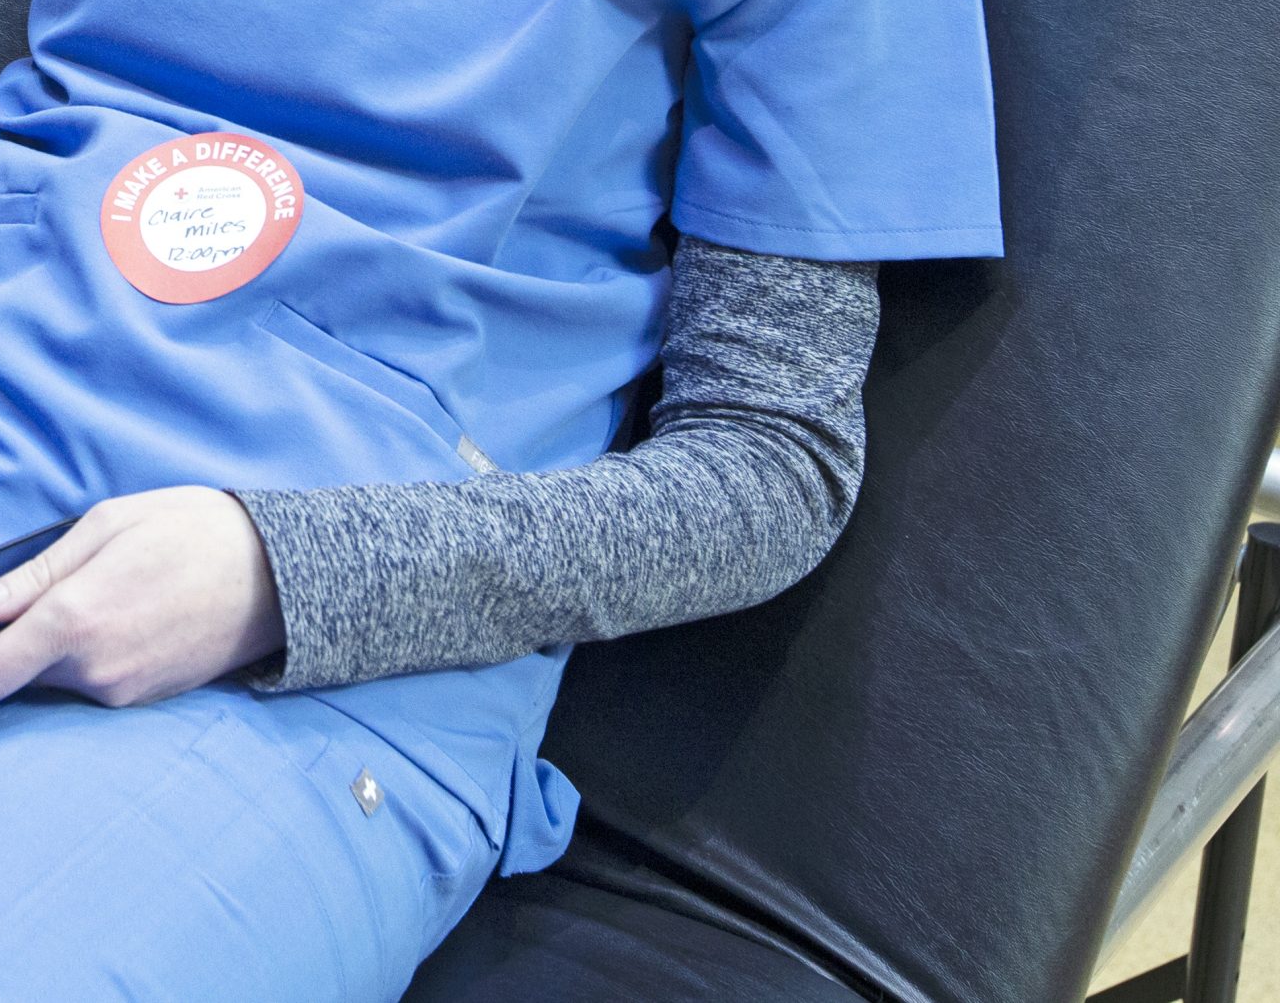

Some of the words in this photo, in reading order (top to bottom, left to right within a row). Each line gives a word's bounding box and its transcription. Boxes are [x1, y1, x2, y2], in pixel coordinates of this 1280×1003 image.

[171, 148, 188, 167] A
[113, 157, 168, 212] MAKE
[195, 141, 296, 222] DIFFERENCE
[110, 214, 132, 222] I
[148, 206, 215, 226] Claire
